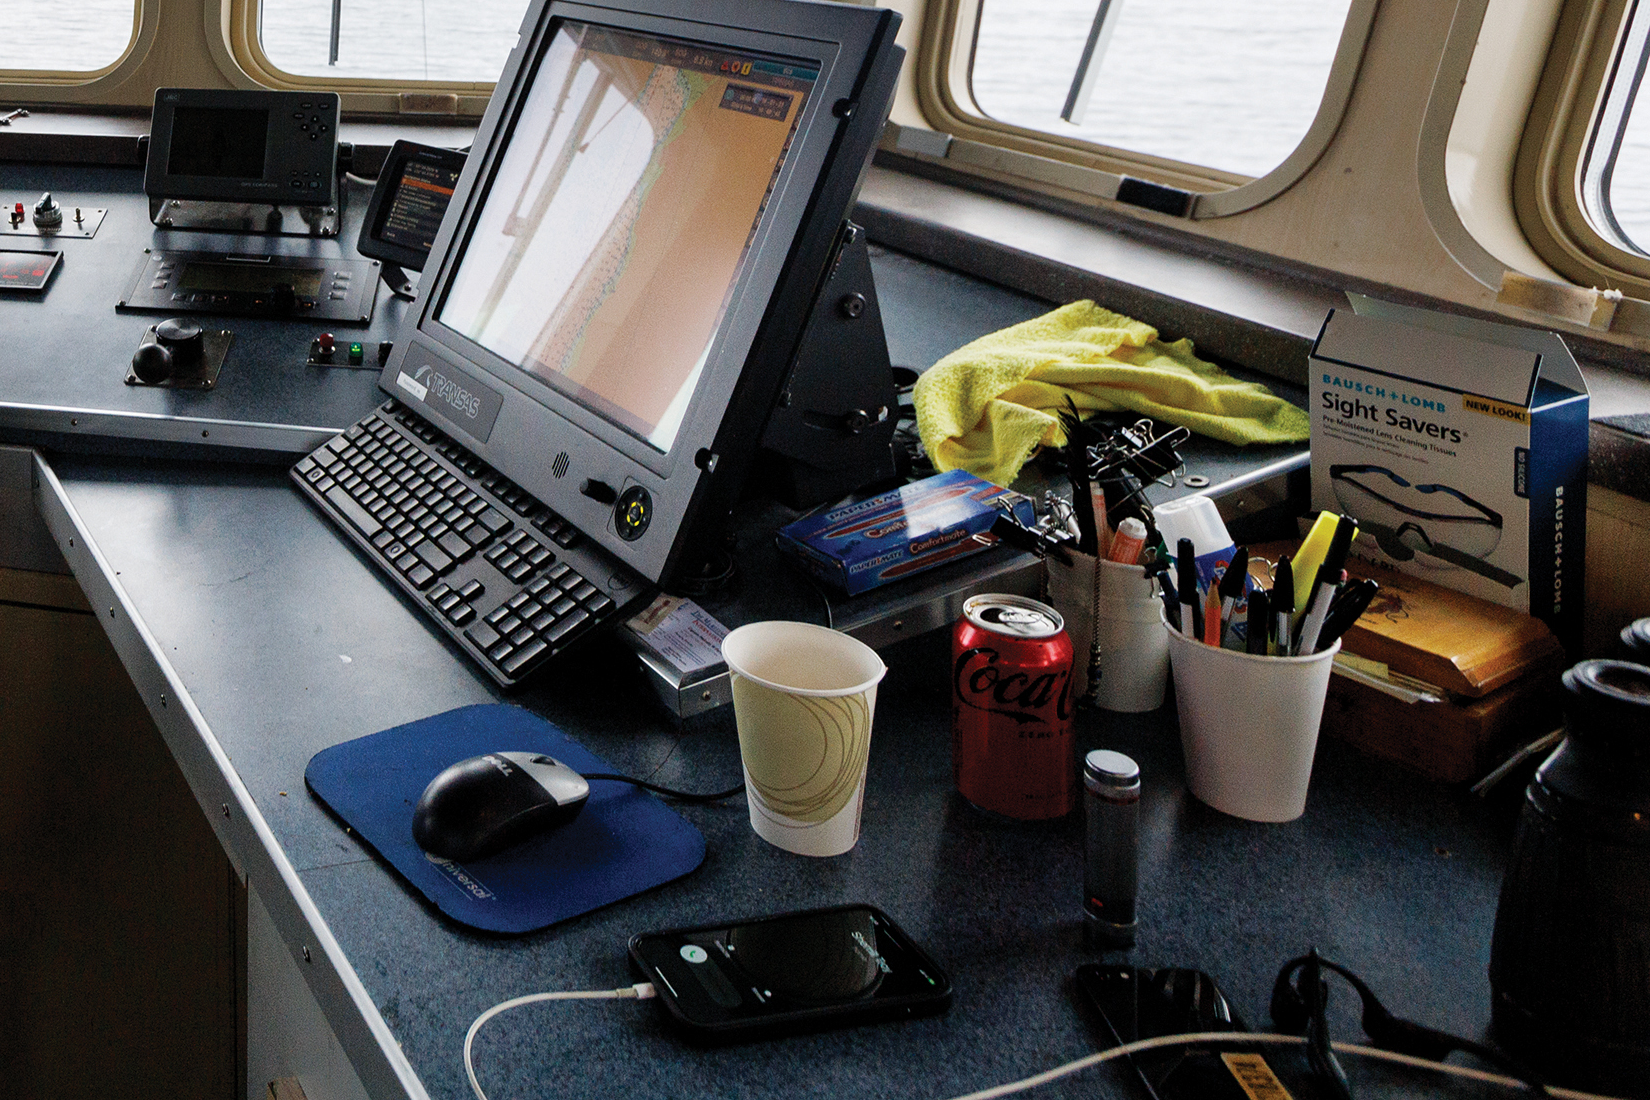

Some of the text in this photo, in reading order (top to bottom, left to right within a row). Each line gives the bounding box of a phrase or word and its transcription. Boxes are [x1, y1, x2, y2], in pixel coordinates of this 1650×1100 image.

[431, 372, 481, 419] TRANSAS
[1322, 374, 1386, 398] BAUSCH
[1401, 394, 1446, 413] LOMB
[1321, 391, 1379, 422] Sight
[1385, 408, 1462, 444] Savers
[1466, 400, 1526, 422] NEW LOOK!
[1376, 429, 1393, 442] Lens
[1394, 433, 1428, 451] Cleaning
[1430, 444, 1457, 458] Tissues
[828, 498, 876, 522] PAPER
[1554, 485, 1564, 554] BAUSCH
[910, 528, 969, 555] Comfortmate
[850, 560, 877, 574] PAPER
[1553, 570, 1562, 614] LOMB
